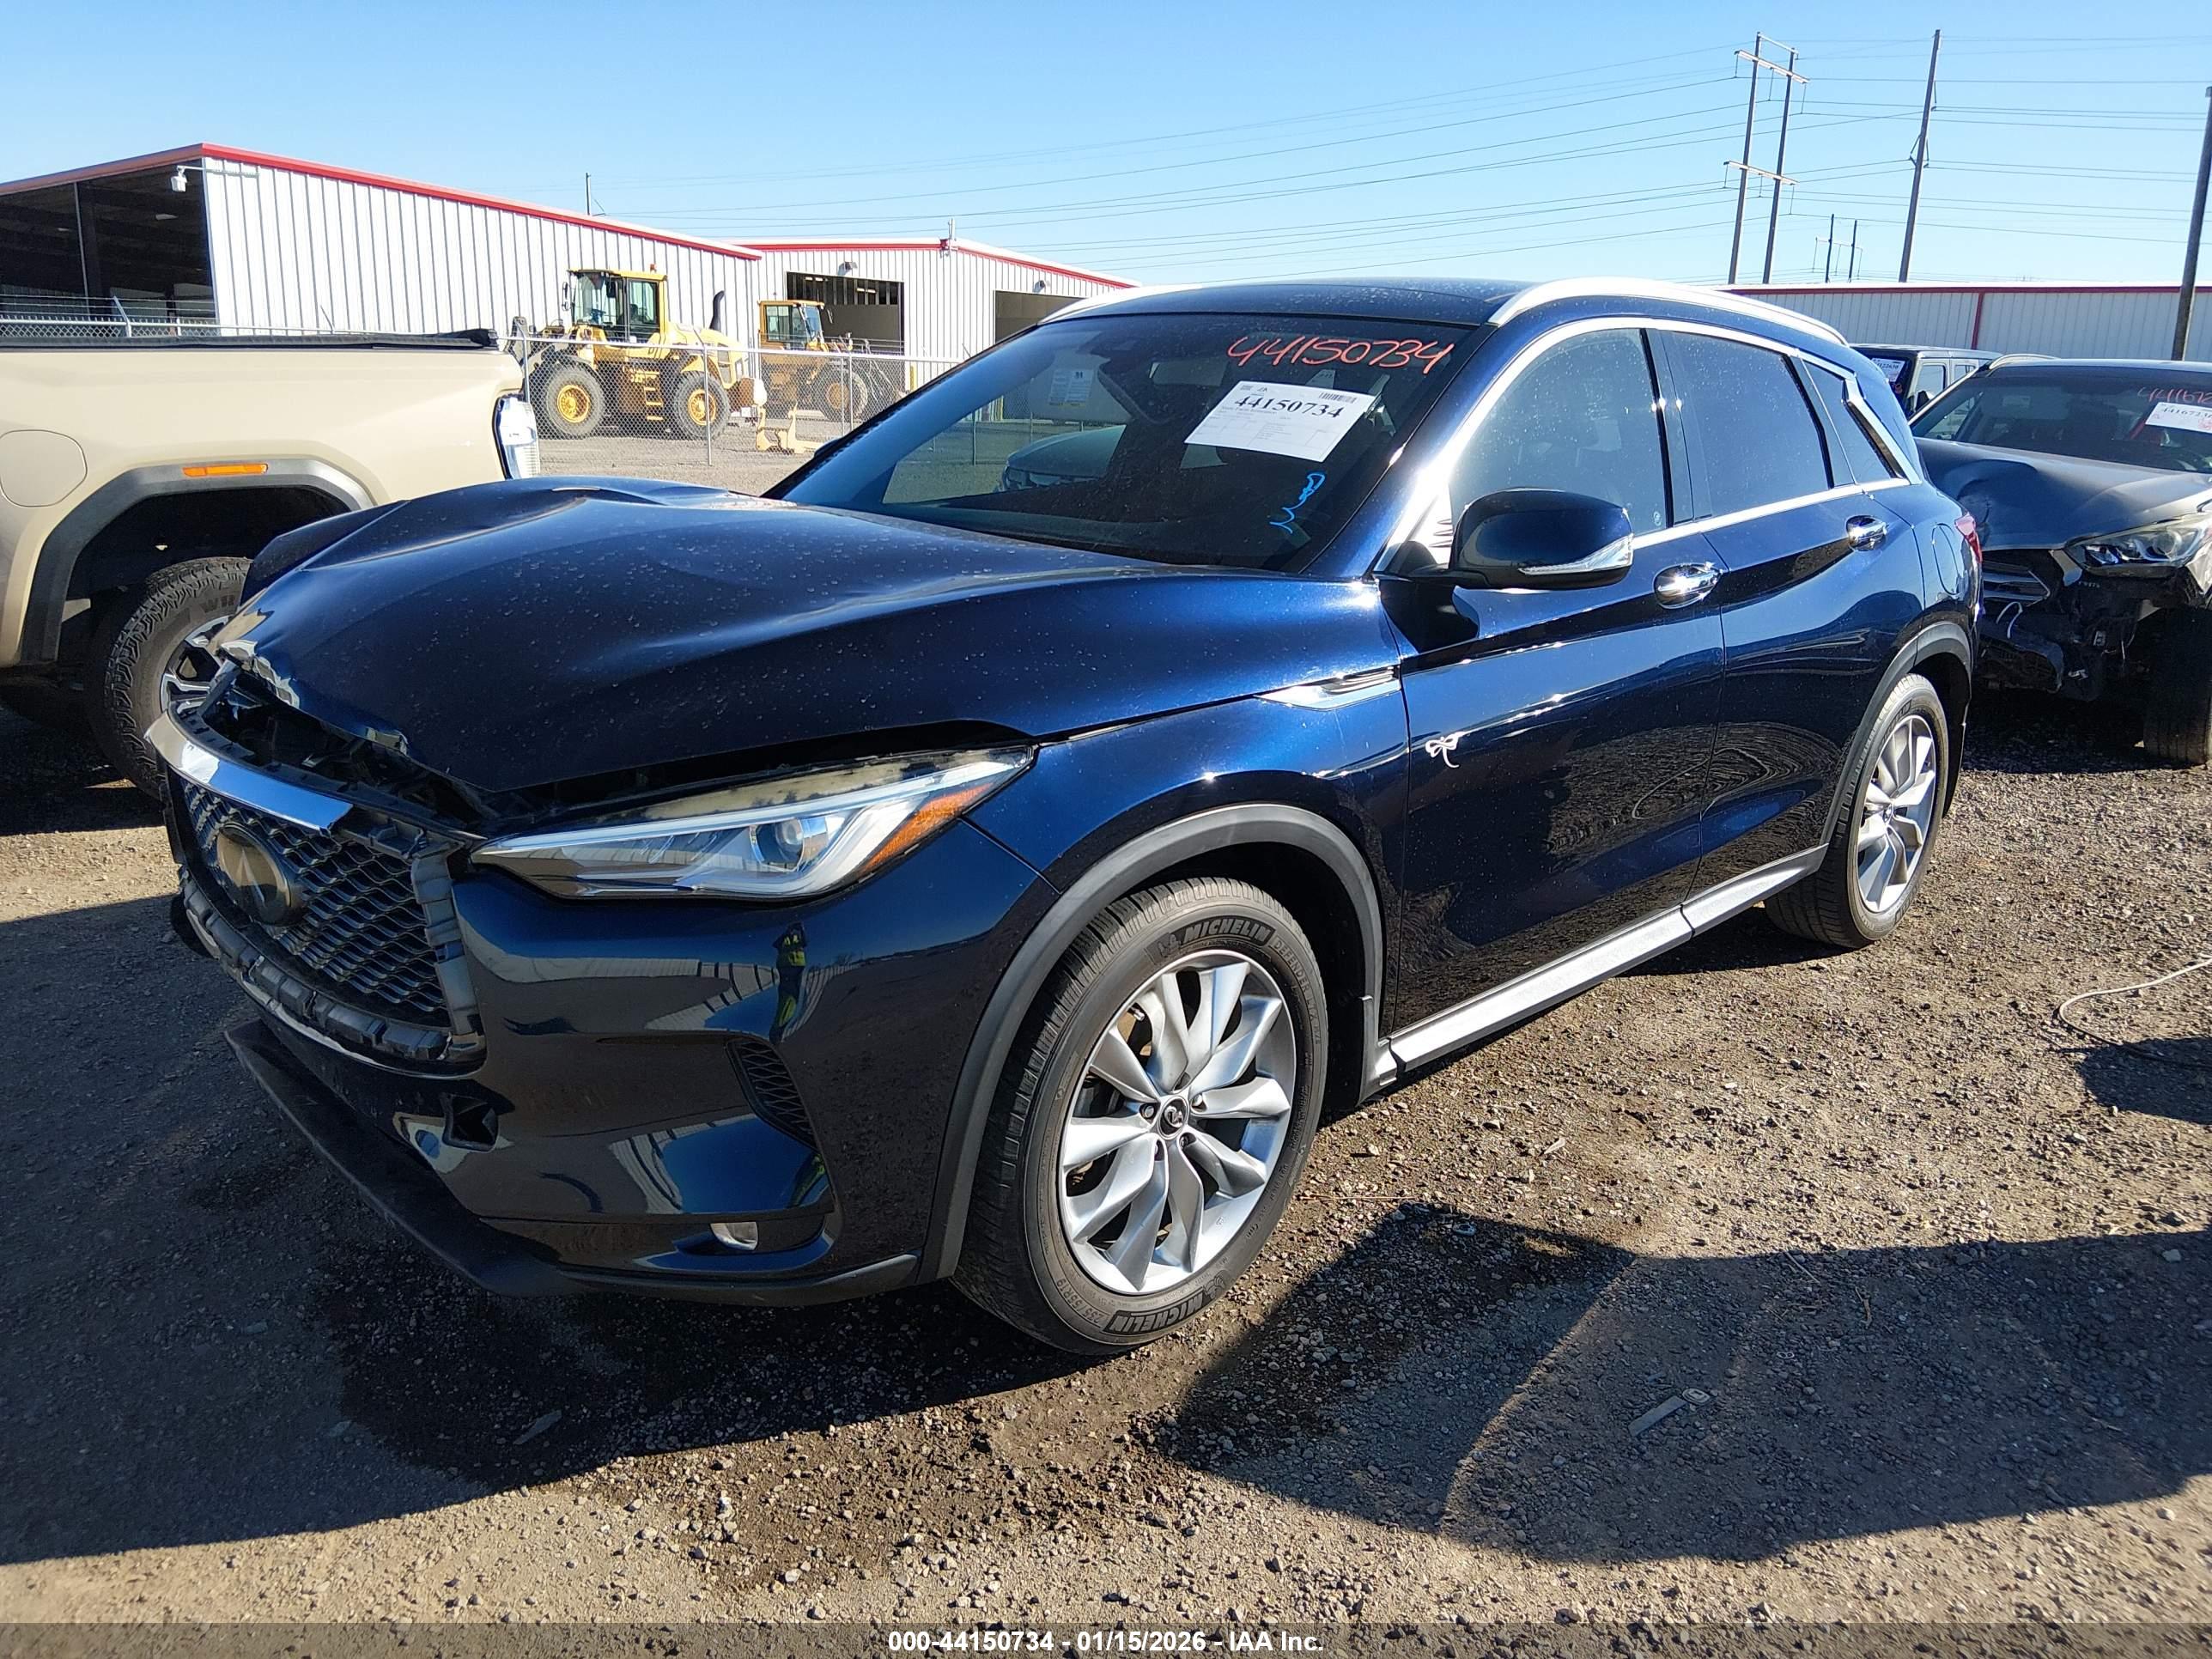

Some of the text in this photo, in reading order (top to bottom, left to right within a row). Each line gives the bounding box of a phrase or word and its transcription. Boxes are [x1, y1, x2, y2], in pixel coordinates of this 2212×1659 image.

[1227, 336, 1455, 374] 44150734
[1234, 395, 1345, 418] 44150734
[1182, 918, 1271, 944] MICHELIN
[1273, 939, 1310, 993] DEFENDER
[1109, 1292, 1203, 1332] MICHELIN
